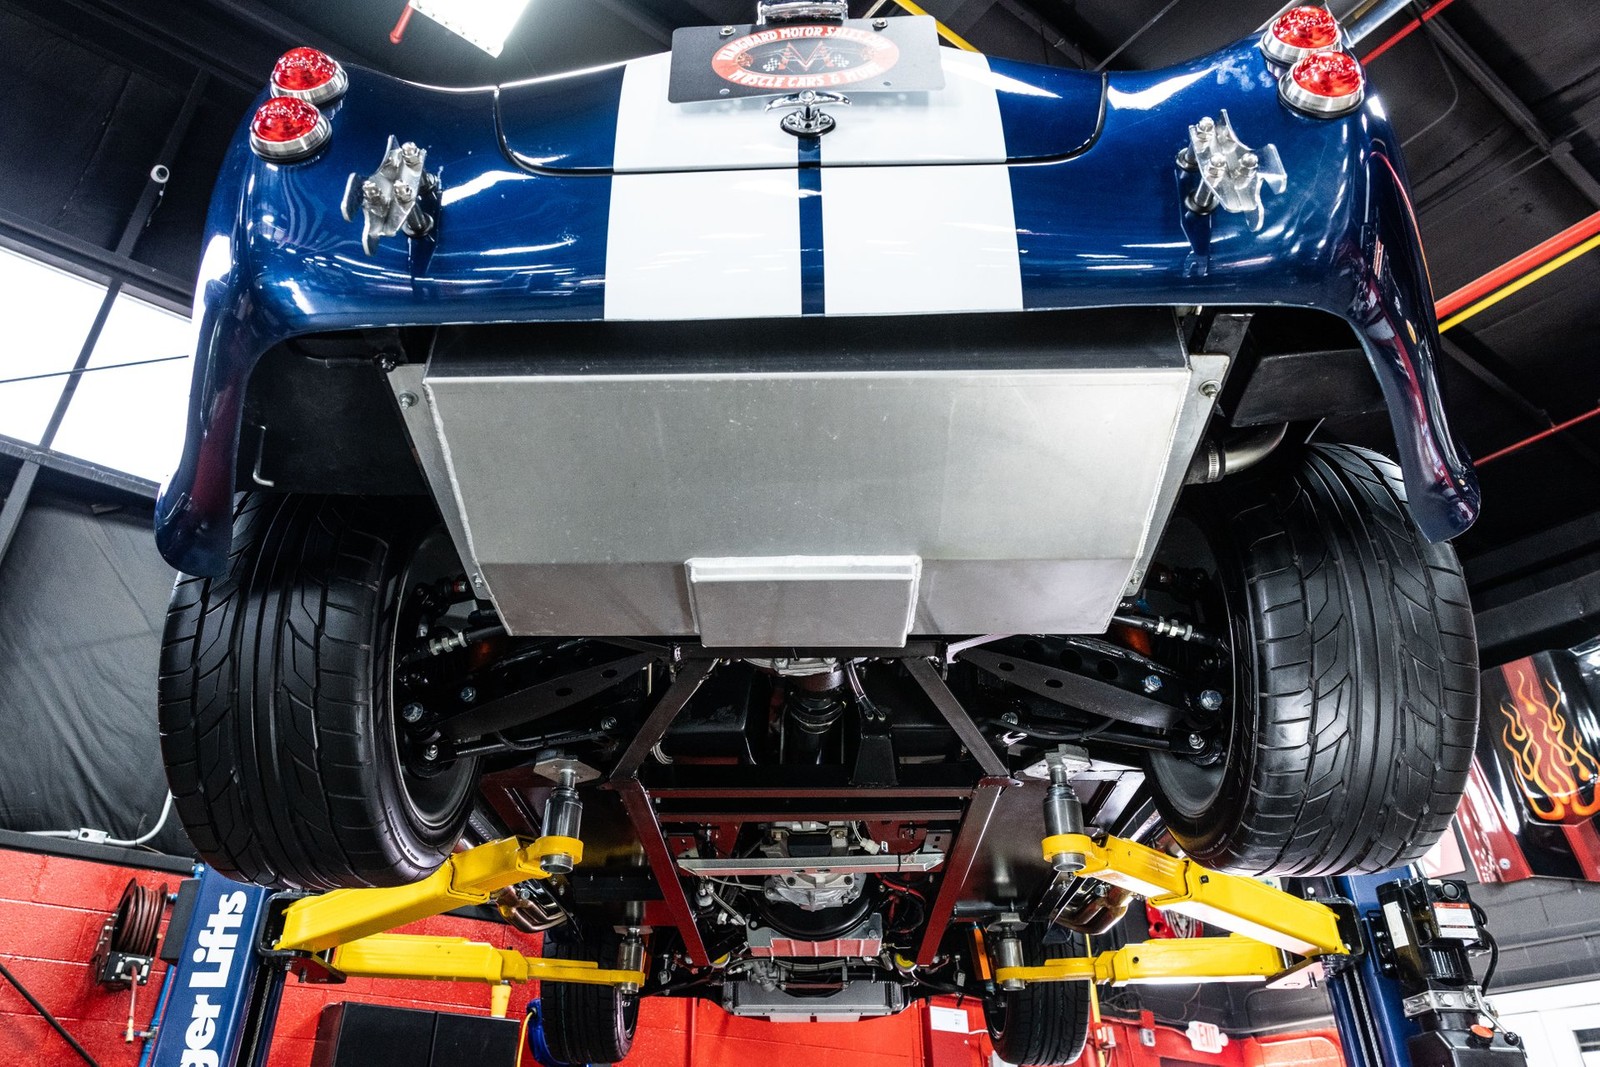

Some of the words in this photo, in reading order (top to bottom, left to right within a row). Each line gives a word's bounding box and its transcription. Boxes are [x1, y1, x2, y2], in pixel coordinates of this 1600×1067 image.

[716, 30, 778, 60] VANGUARD
[779, 26, 823, 39] MOTOR
[727, 69, 786, 87] MUSCLE
[787, 76, 825, 88] CARS
[188, 890, 247, 988] Lifts
